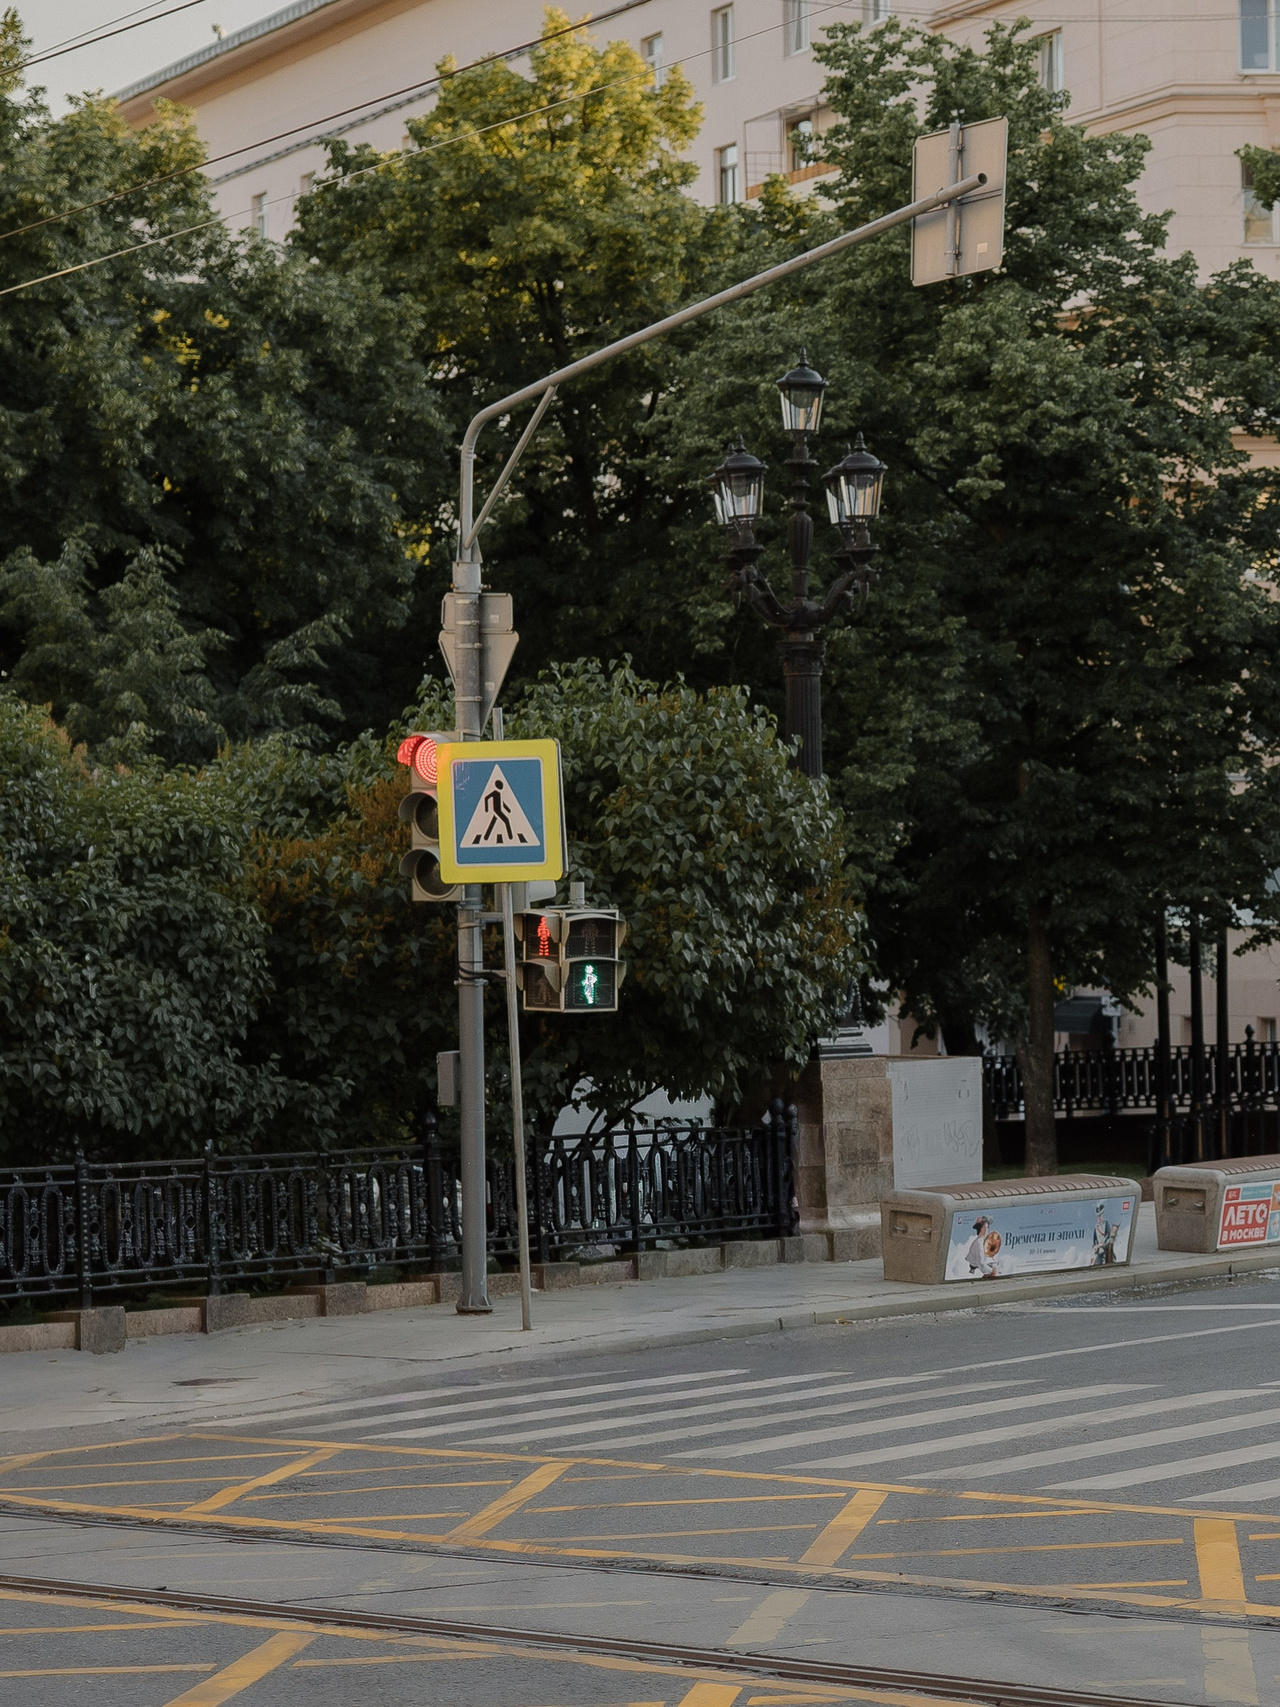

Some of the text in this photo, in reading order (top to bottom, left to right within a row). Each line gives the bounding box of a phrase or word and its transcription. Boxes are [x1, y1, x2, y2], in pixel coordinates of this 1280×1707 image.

[1224, 1203, 1268, 1227] ЛЕТО
[1004, 1229, 1085, 1249] Времена и эпохи
[1222, 1226, 1265, 1241] В МОСКВЕ
